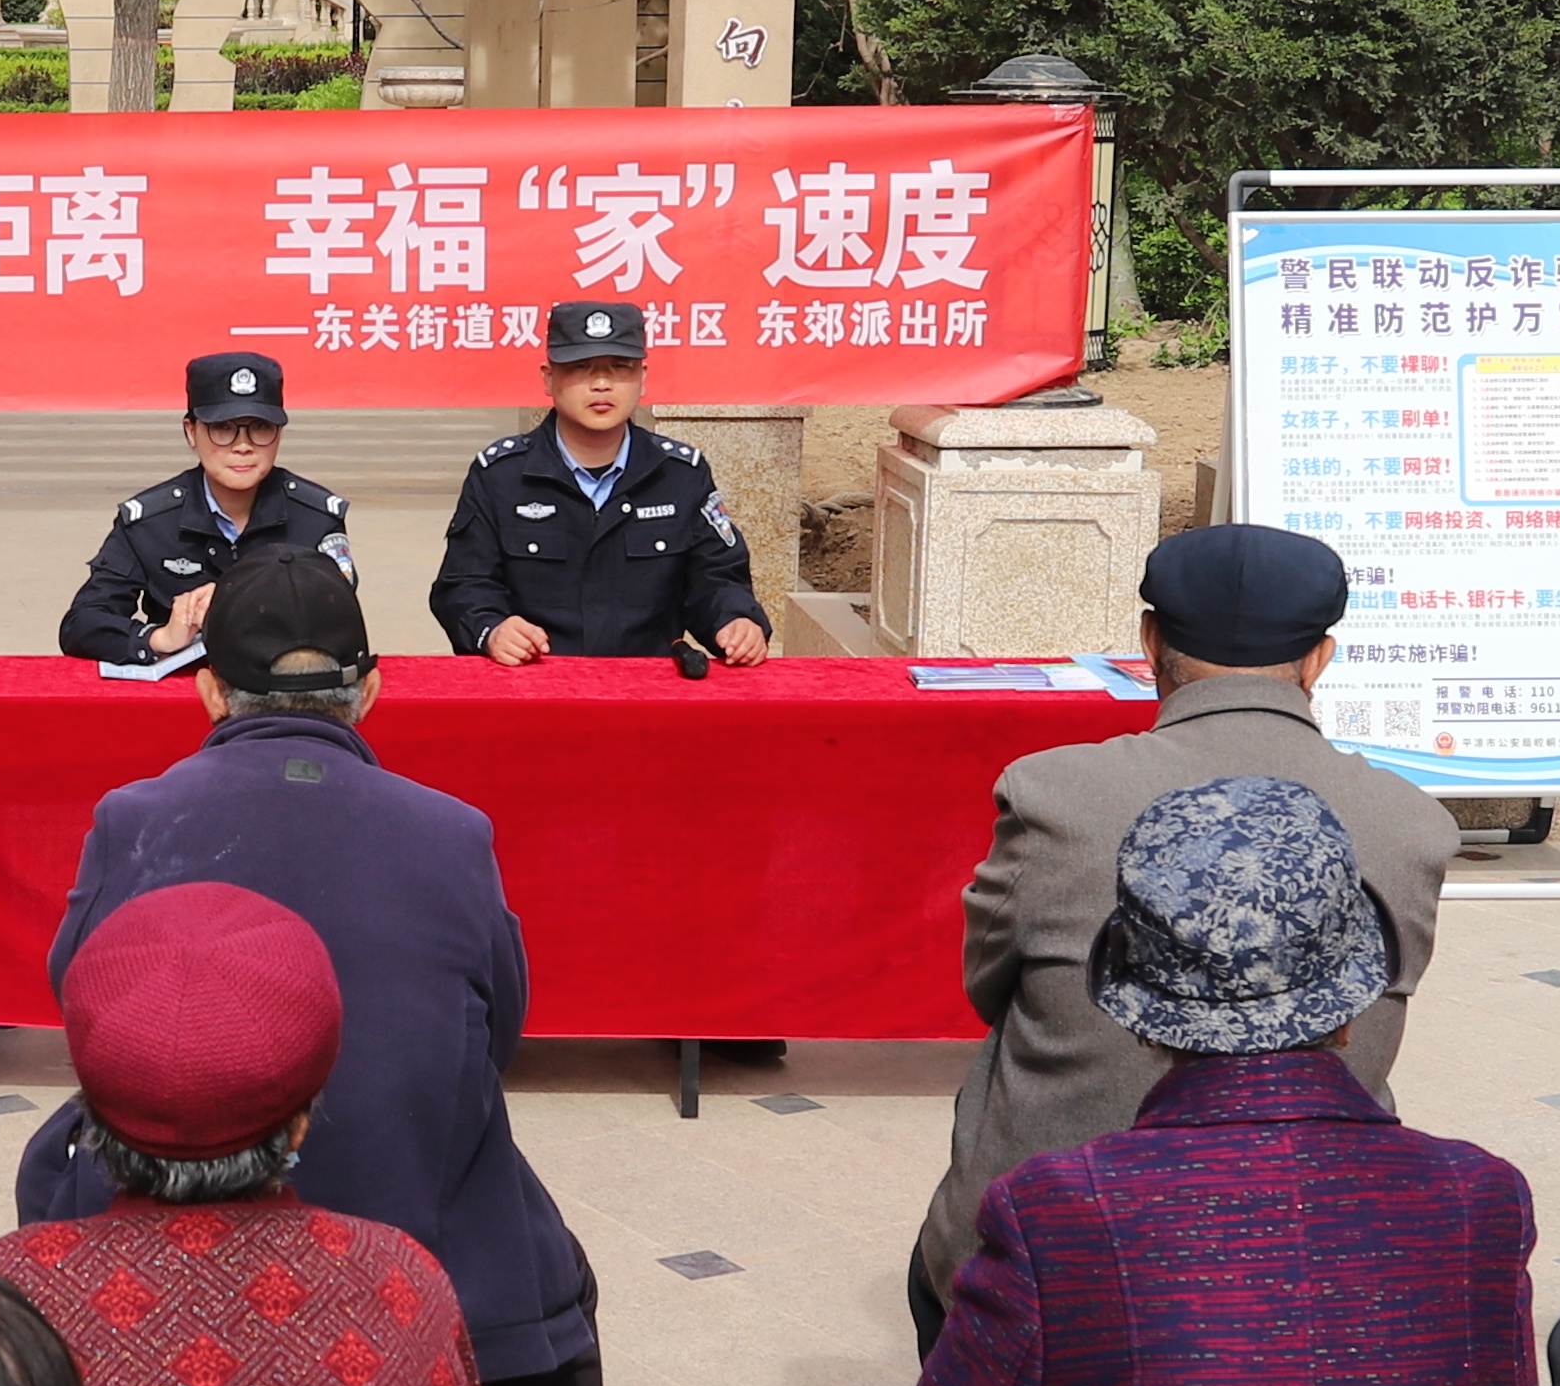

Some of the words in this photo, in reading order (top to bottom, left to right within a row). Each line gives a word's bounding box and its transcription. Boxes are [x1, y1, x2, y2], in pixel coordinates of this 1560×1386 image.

[265, 160, 988, 293] 幸福“家”速度
[231, 299, 727, 352] ——东关街道双社区
[758, 301, 986, 347] 东郊派出所
